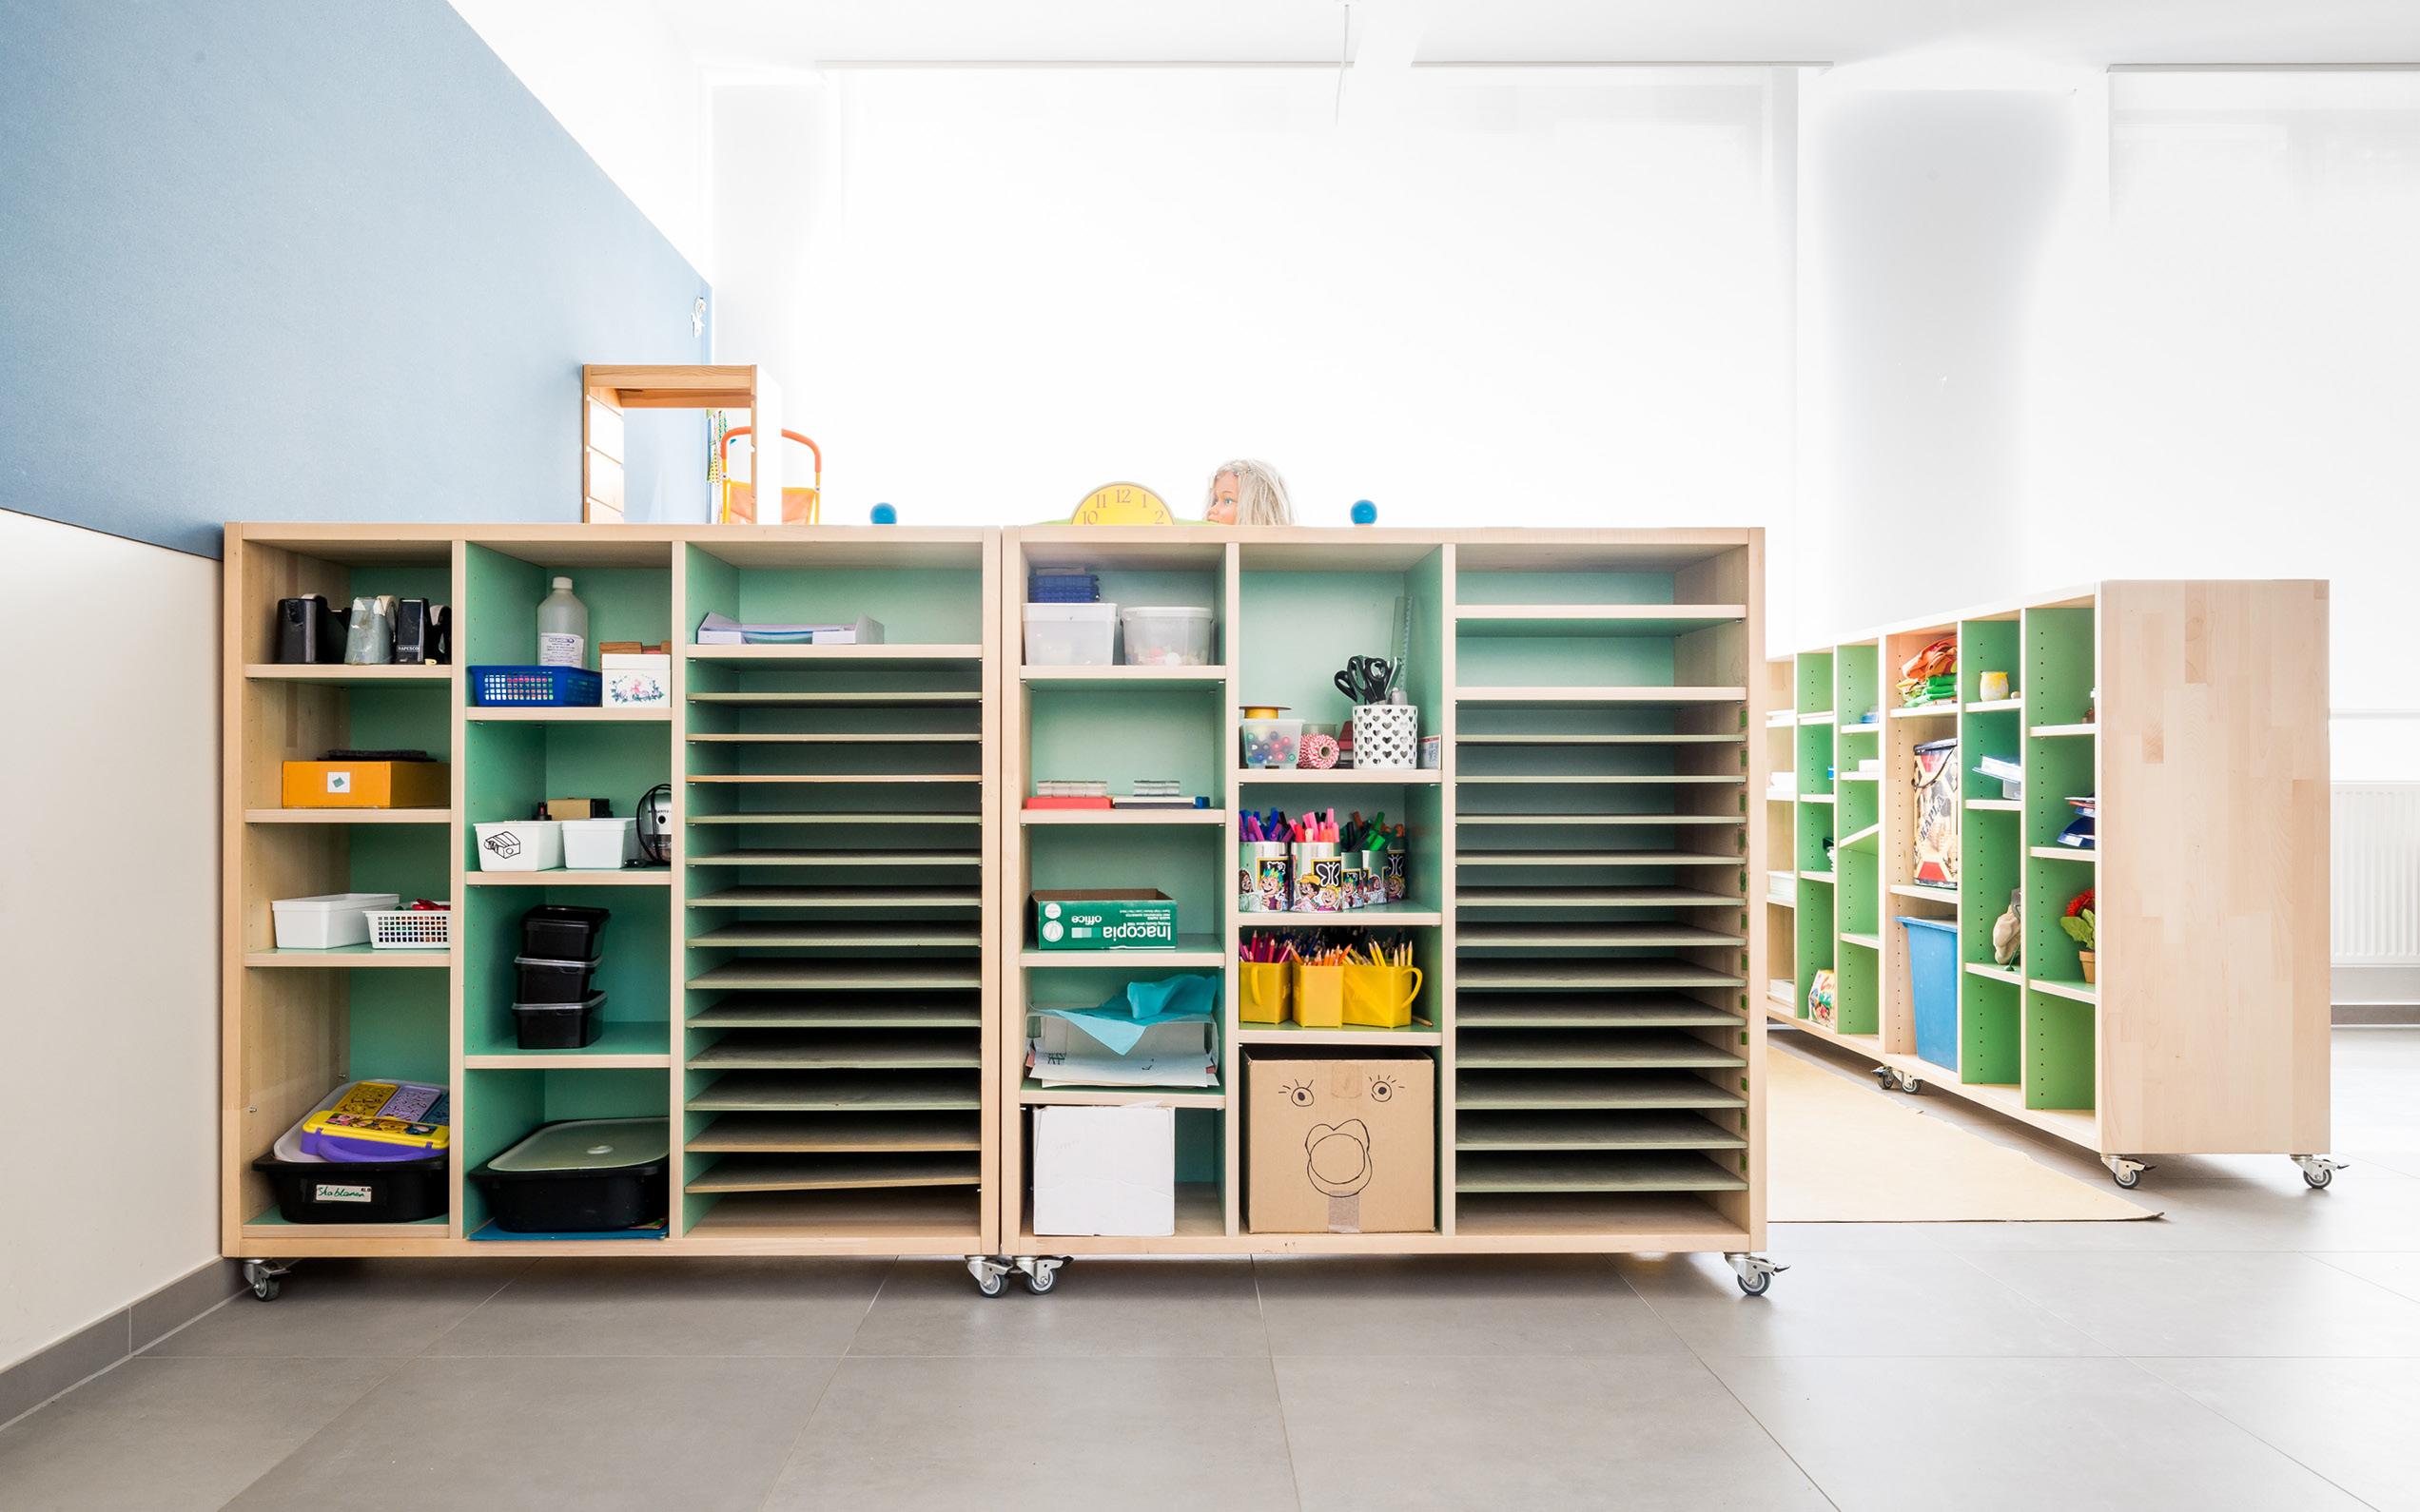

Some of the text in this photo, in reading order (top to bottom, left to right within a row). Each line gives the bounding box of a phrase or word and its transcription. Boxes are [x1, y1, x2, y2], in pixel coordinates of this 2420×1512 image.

[1096, 494, 1107, 509] 11
[1116, 488, 1131, 503] 12
[1142, 494, 1147, 509] 1
[1082, 510, 1098, 525] 10
[1154, 510, 1164, 525] 2
[1920, 794, 1946, 843] KAPLA
[1071, 915, 1103, 926] office
[1103, 922, 1171, 941] Inacopia
